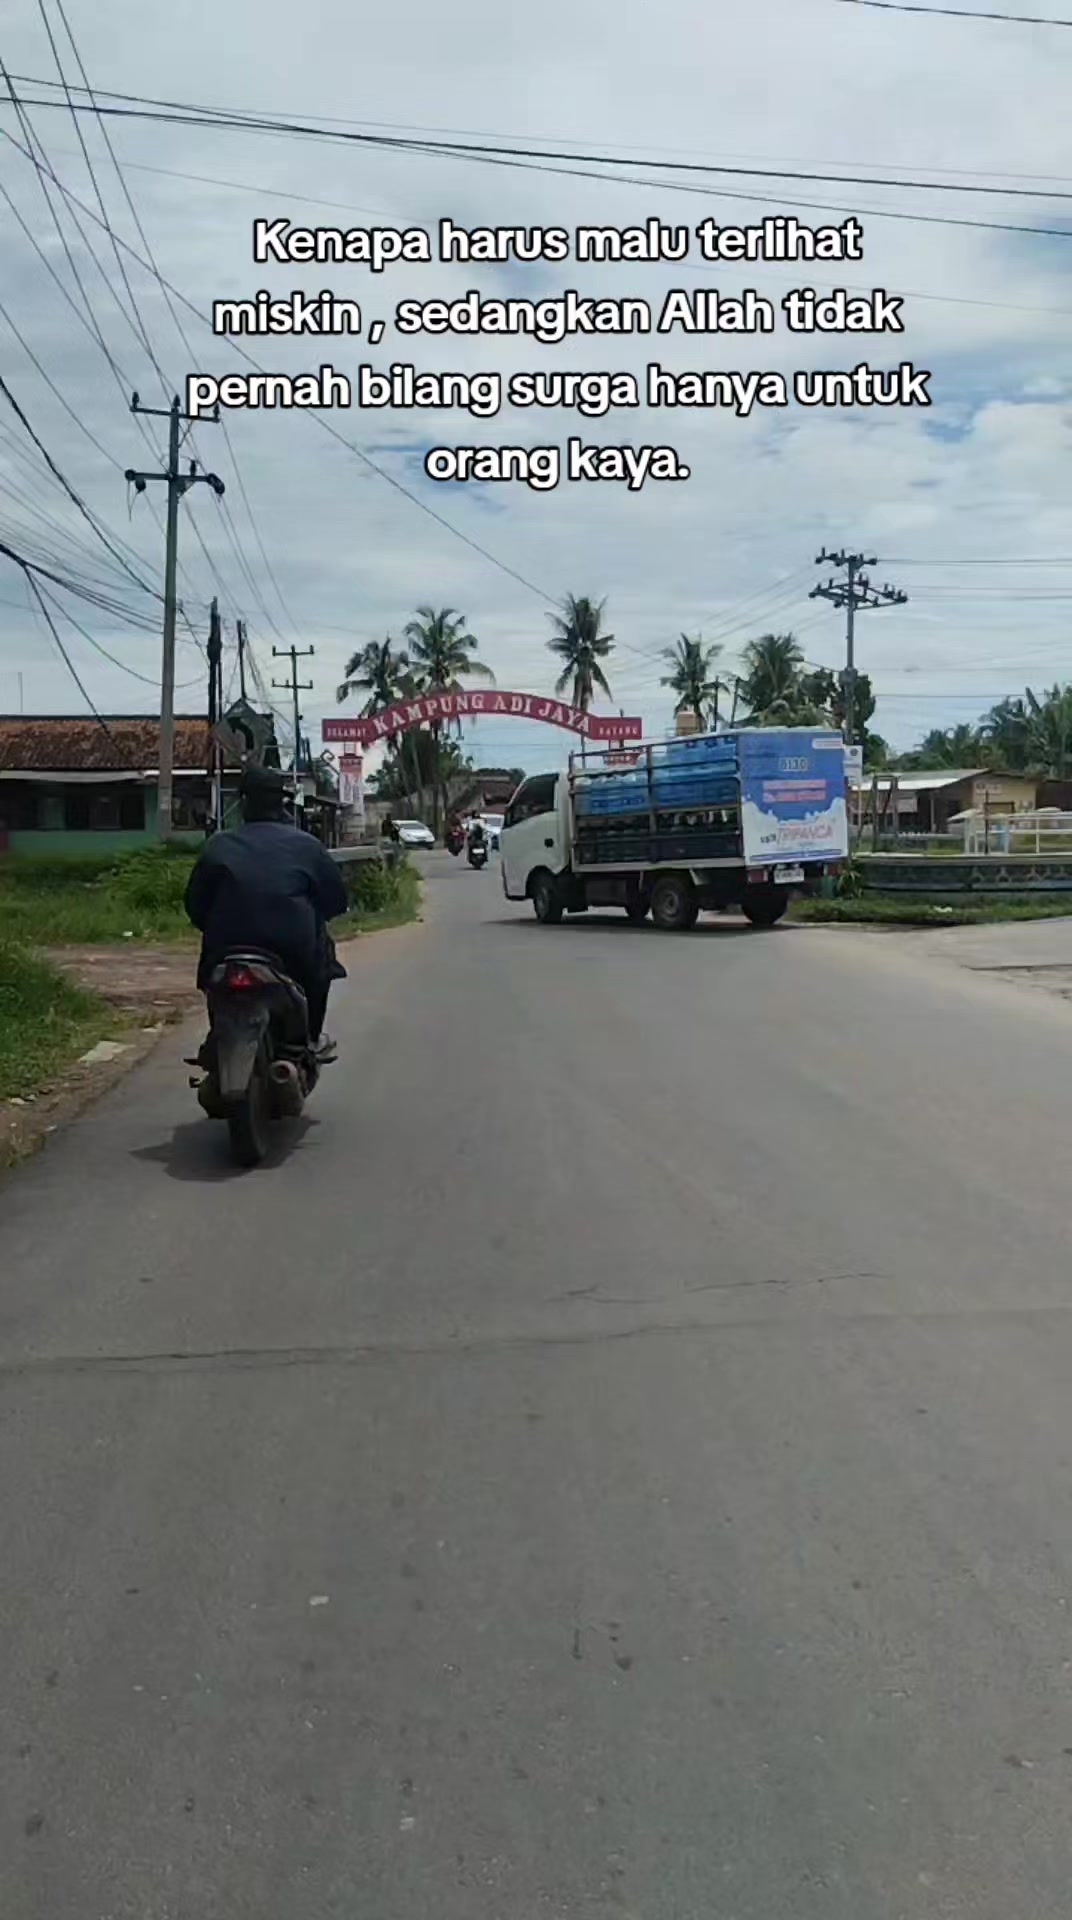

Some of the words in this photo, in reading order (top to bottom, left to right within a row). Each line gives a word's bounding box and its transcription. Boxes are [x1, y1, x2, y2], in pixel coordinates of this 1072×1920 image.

[372, 692, 485, 735] KAMPUNG
[493, 694, 533, 713] ADI
[538, 701, 590, 733] JAYA
